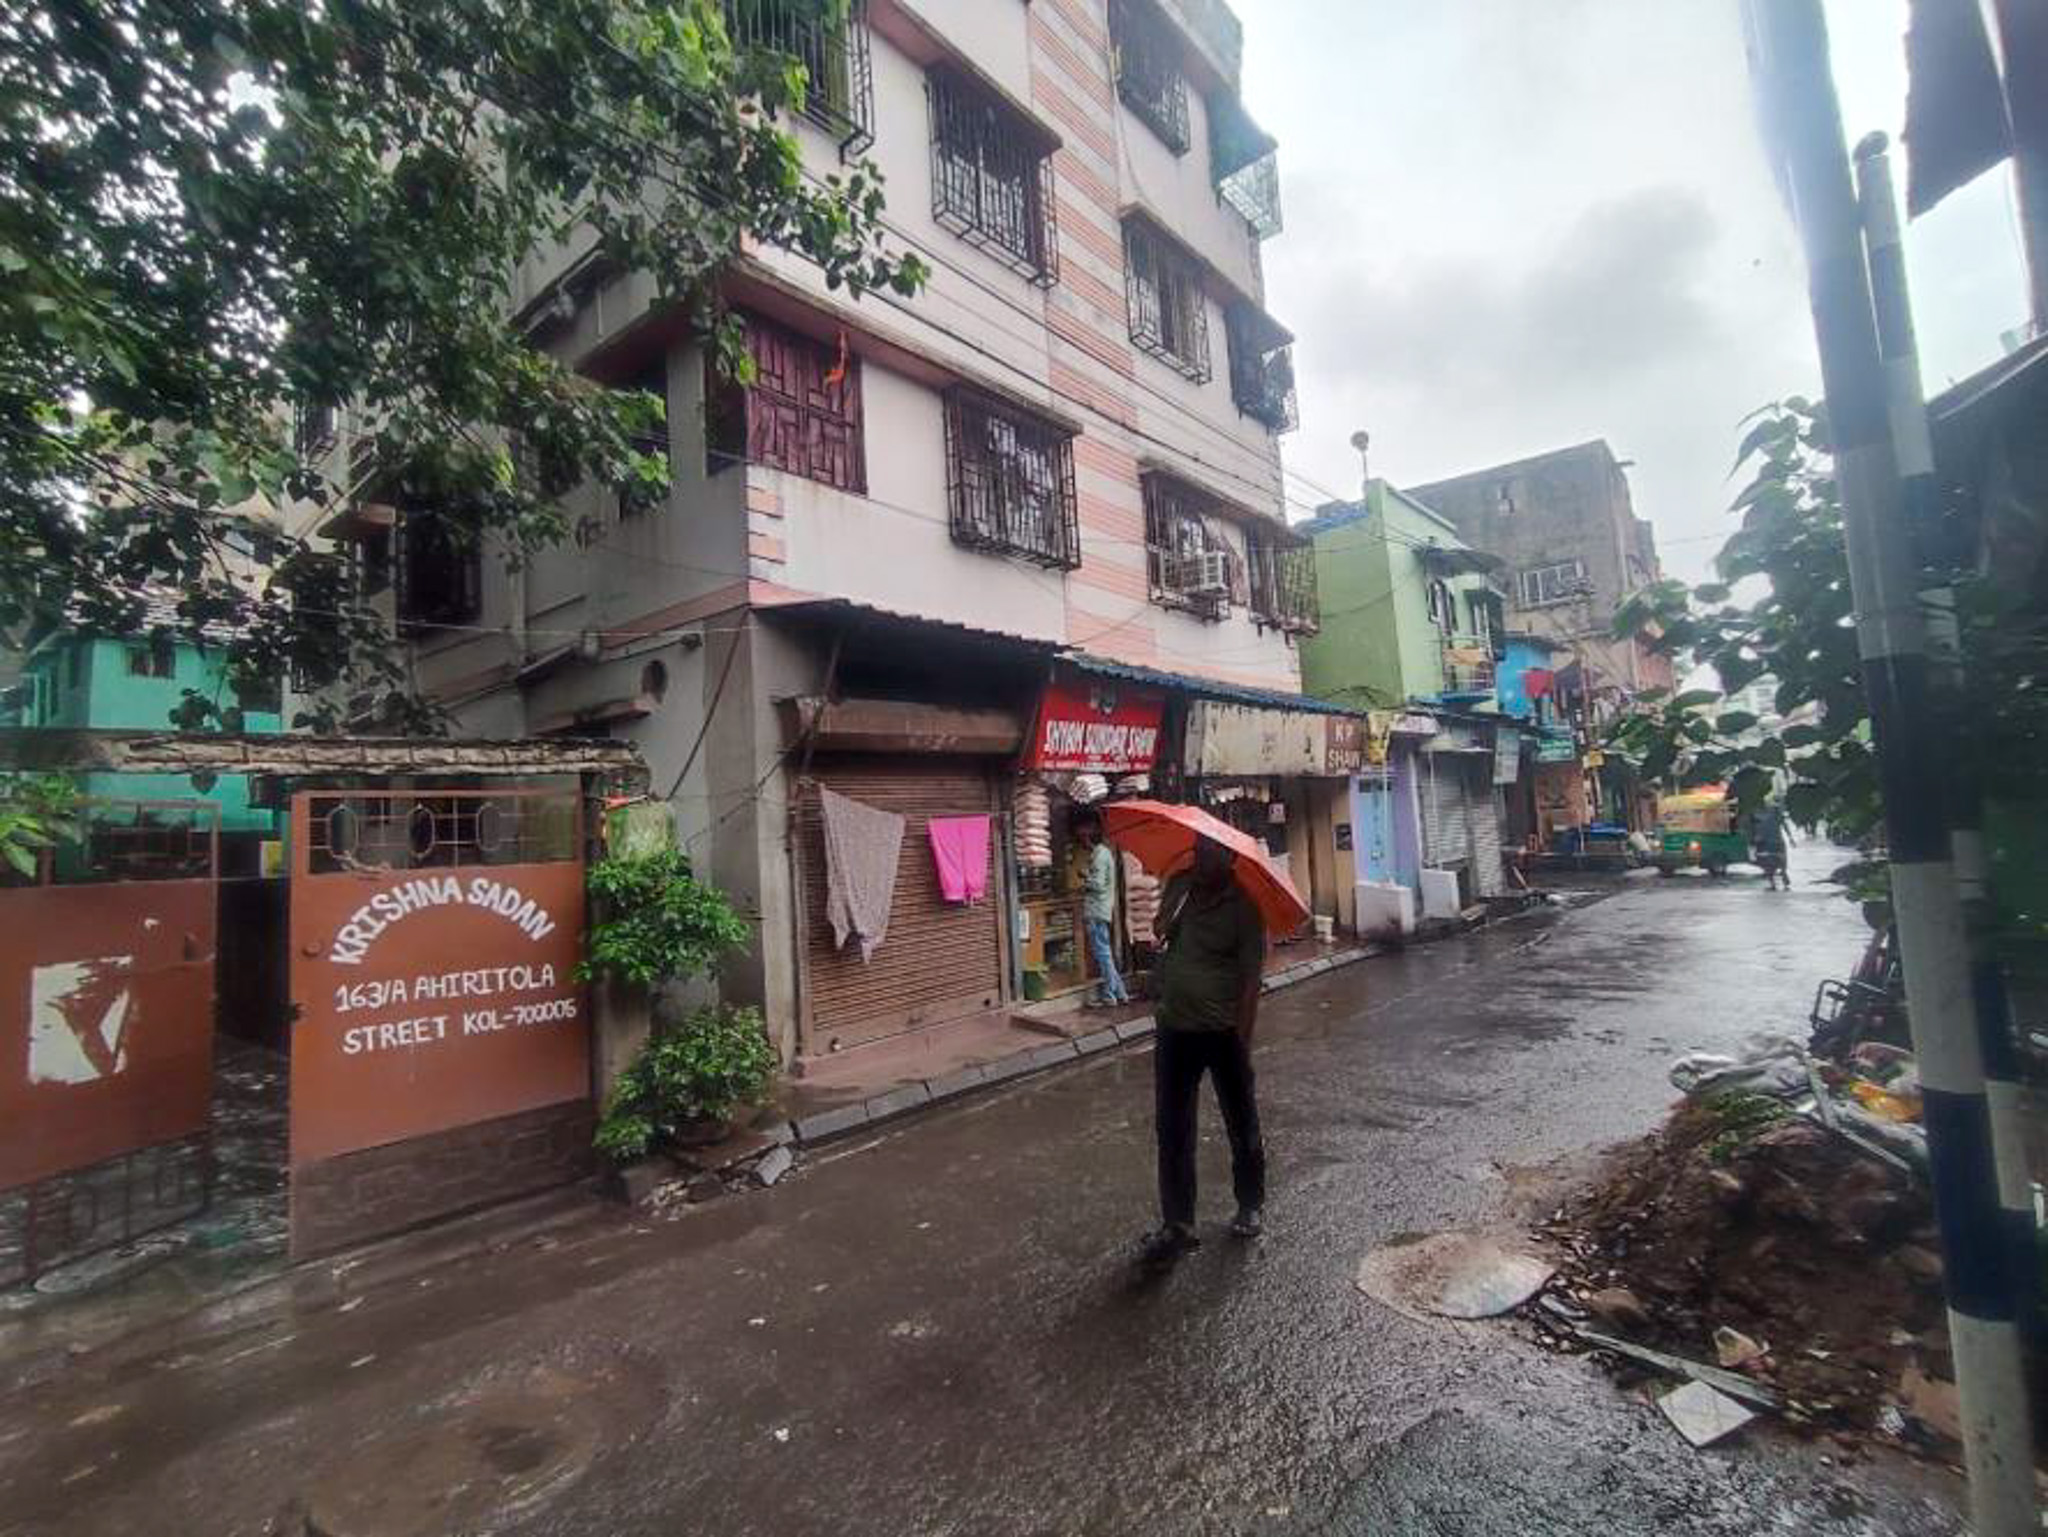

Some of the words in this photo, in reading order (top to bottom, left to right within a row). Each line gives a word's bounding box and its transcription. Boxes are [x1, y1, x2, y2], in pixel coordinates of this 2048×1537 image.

[1328, 748, 1360, 769] SHAW
[330, 876, 463, 965] KRISHNA
[467, 877, 556, 942] SADAN
[334, 980, 408, 1013] 163/A
[414, 963, 556, 1000] AHIRITOLA
[342, 1016, 449, 1055] STREET
